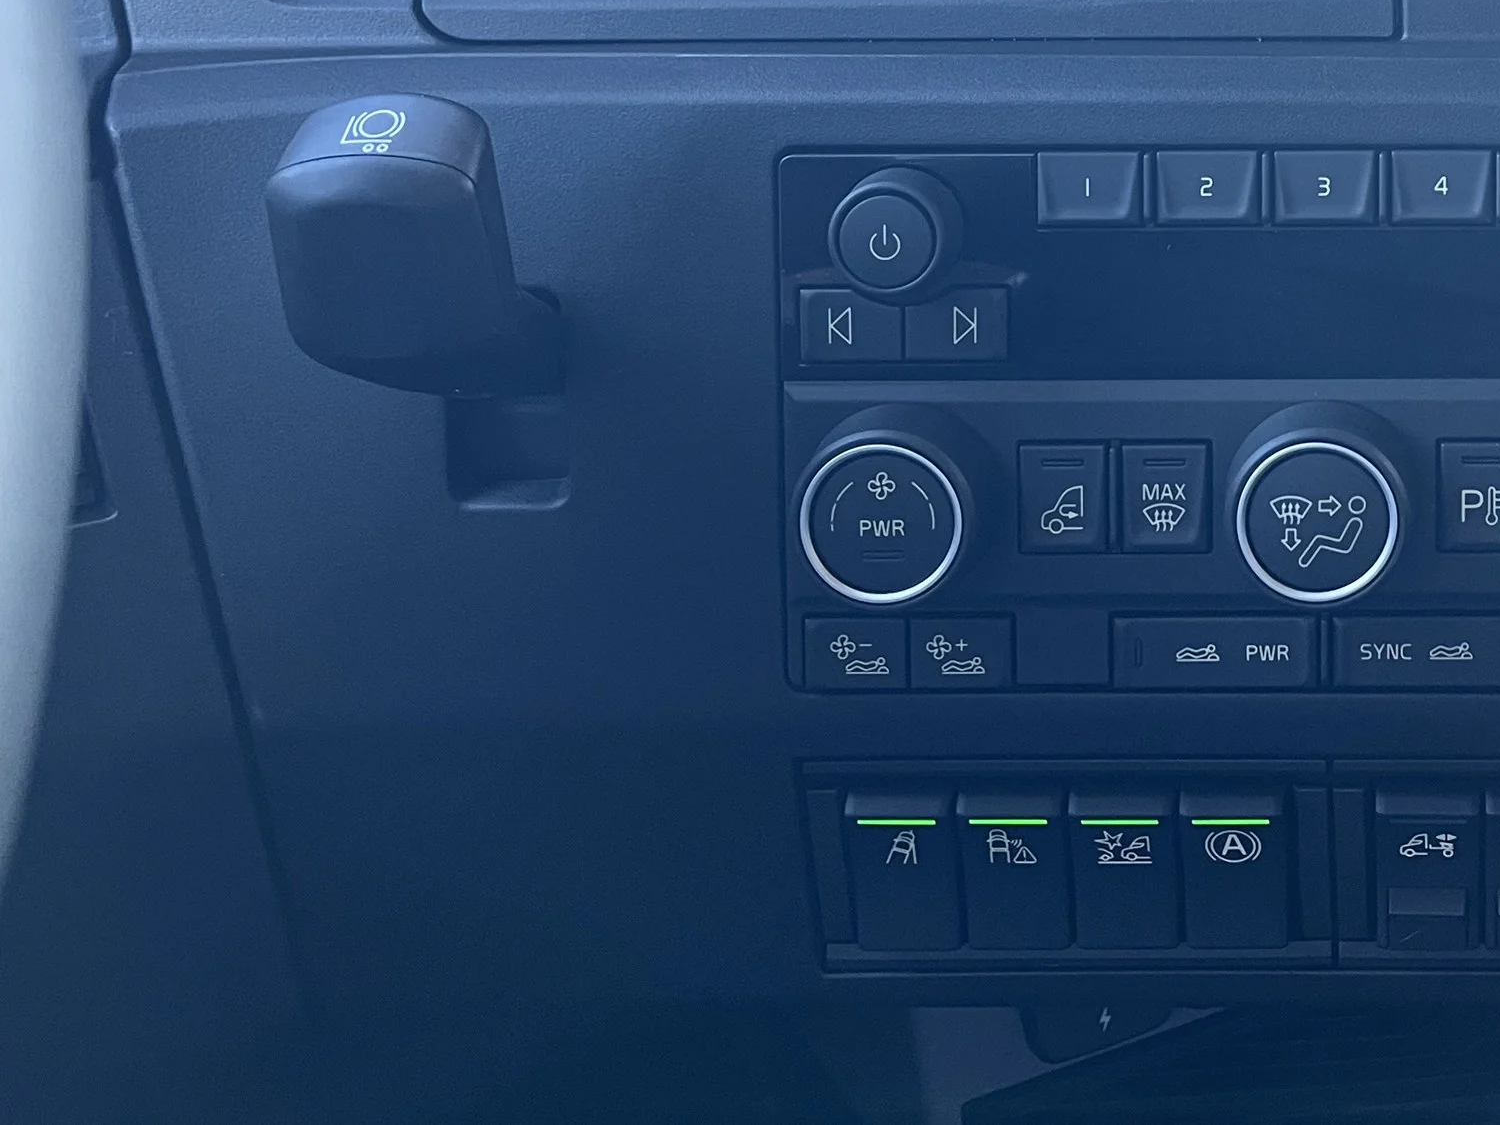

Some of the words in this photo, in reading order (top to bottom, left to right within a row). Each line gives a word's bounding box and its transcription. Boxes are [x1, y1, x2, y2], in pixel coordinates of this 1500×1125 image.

[1200, 177, 1213, 197] 2
[1317, 177, 1331, 197] 3
[1434, 176, 1449, 196] 4
[1142, 484, 1186, 501] MAX
[1461, 489, 1484, 523] P
[859, 520, 905, 537] PWR
[1246, 644, 1289, 662] PWR
[1360, 643, 1412, 660] SYNC
[1222, 834, 1247, 856] A
